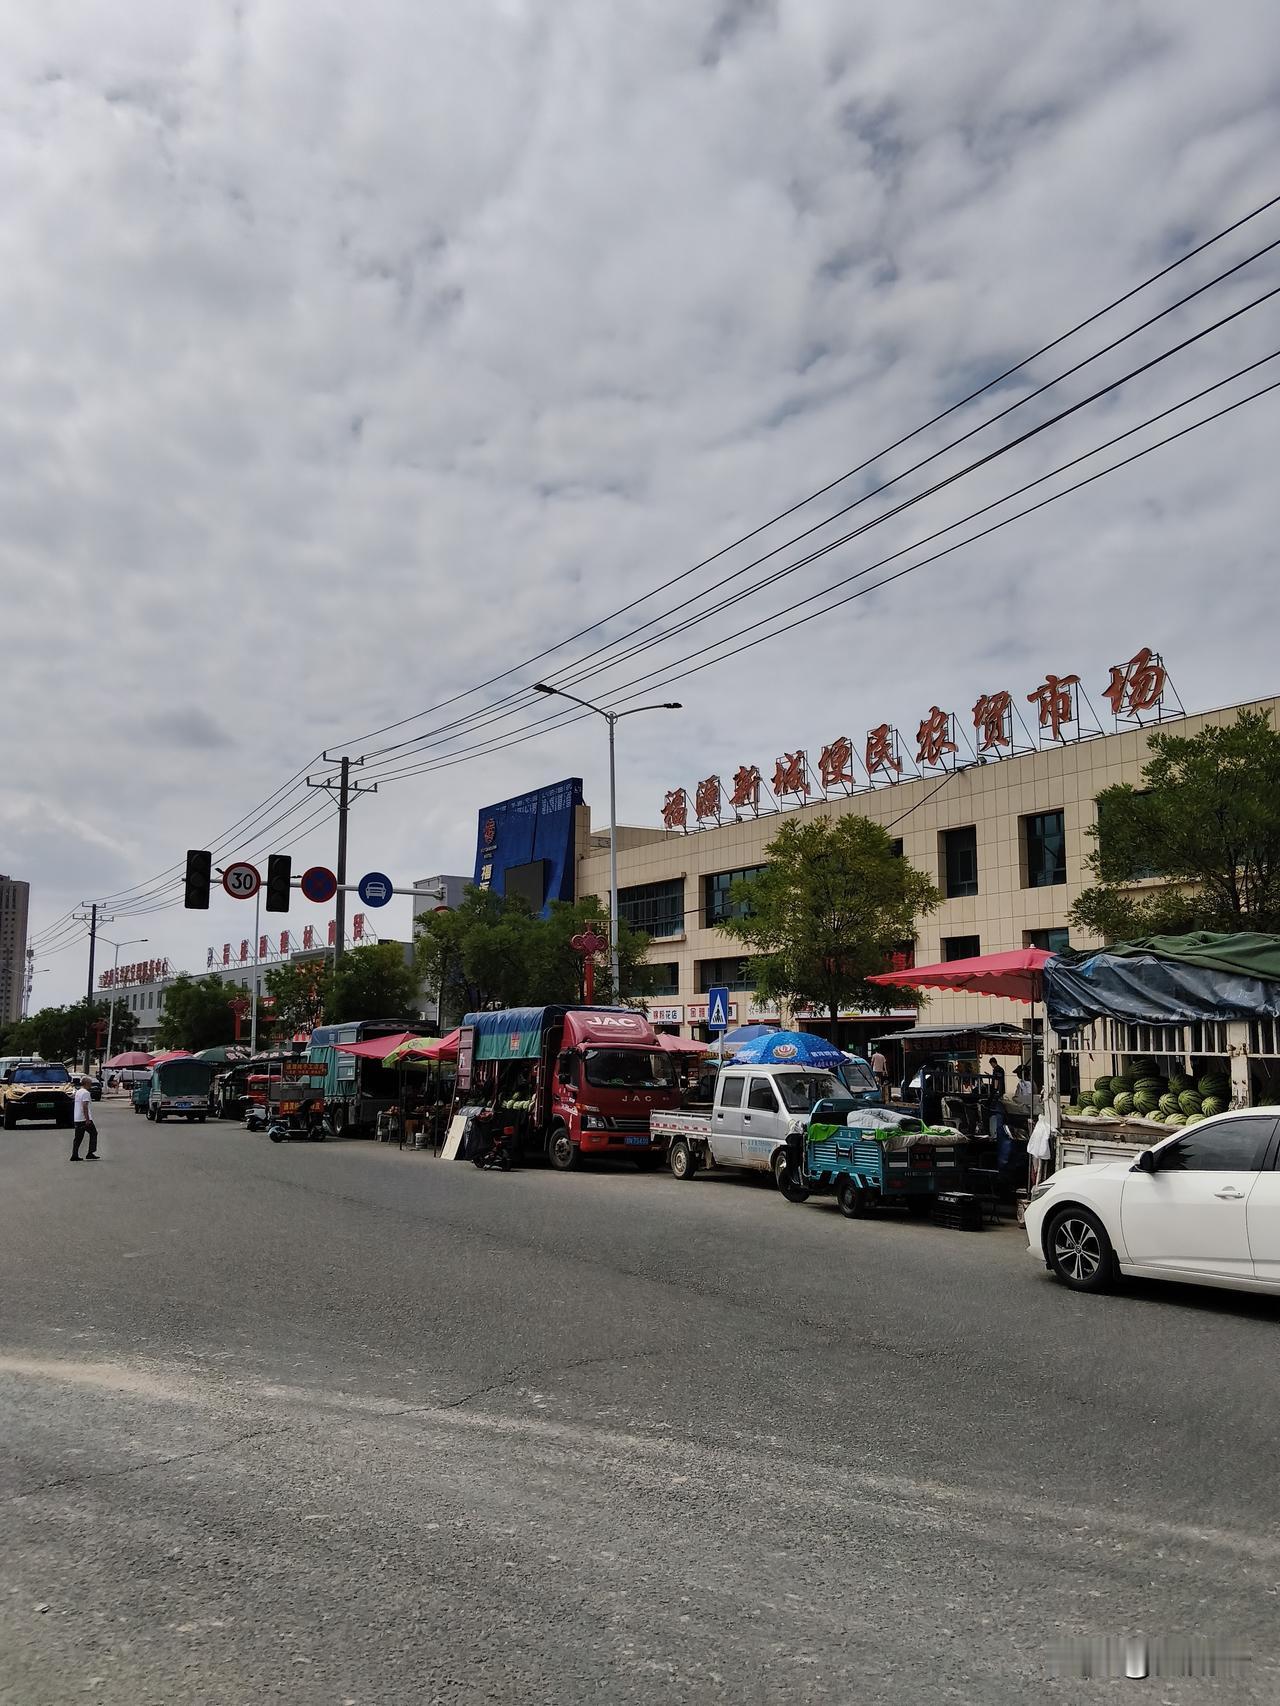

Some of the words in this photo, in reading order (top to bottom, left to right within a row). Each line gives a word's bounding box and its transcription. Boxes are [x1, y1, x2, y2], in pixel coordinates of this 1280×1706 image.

[661, 648, 1167, 829] 福源新城便民农贸市场
[231, 871, 253, 891] 30
[585, 1016, 637, 1028] JAC
